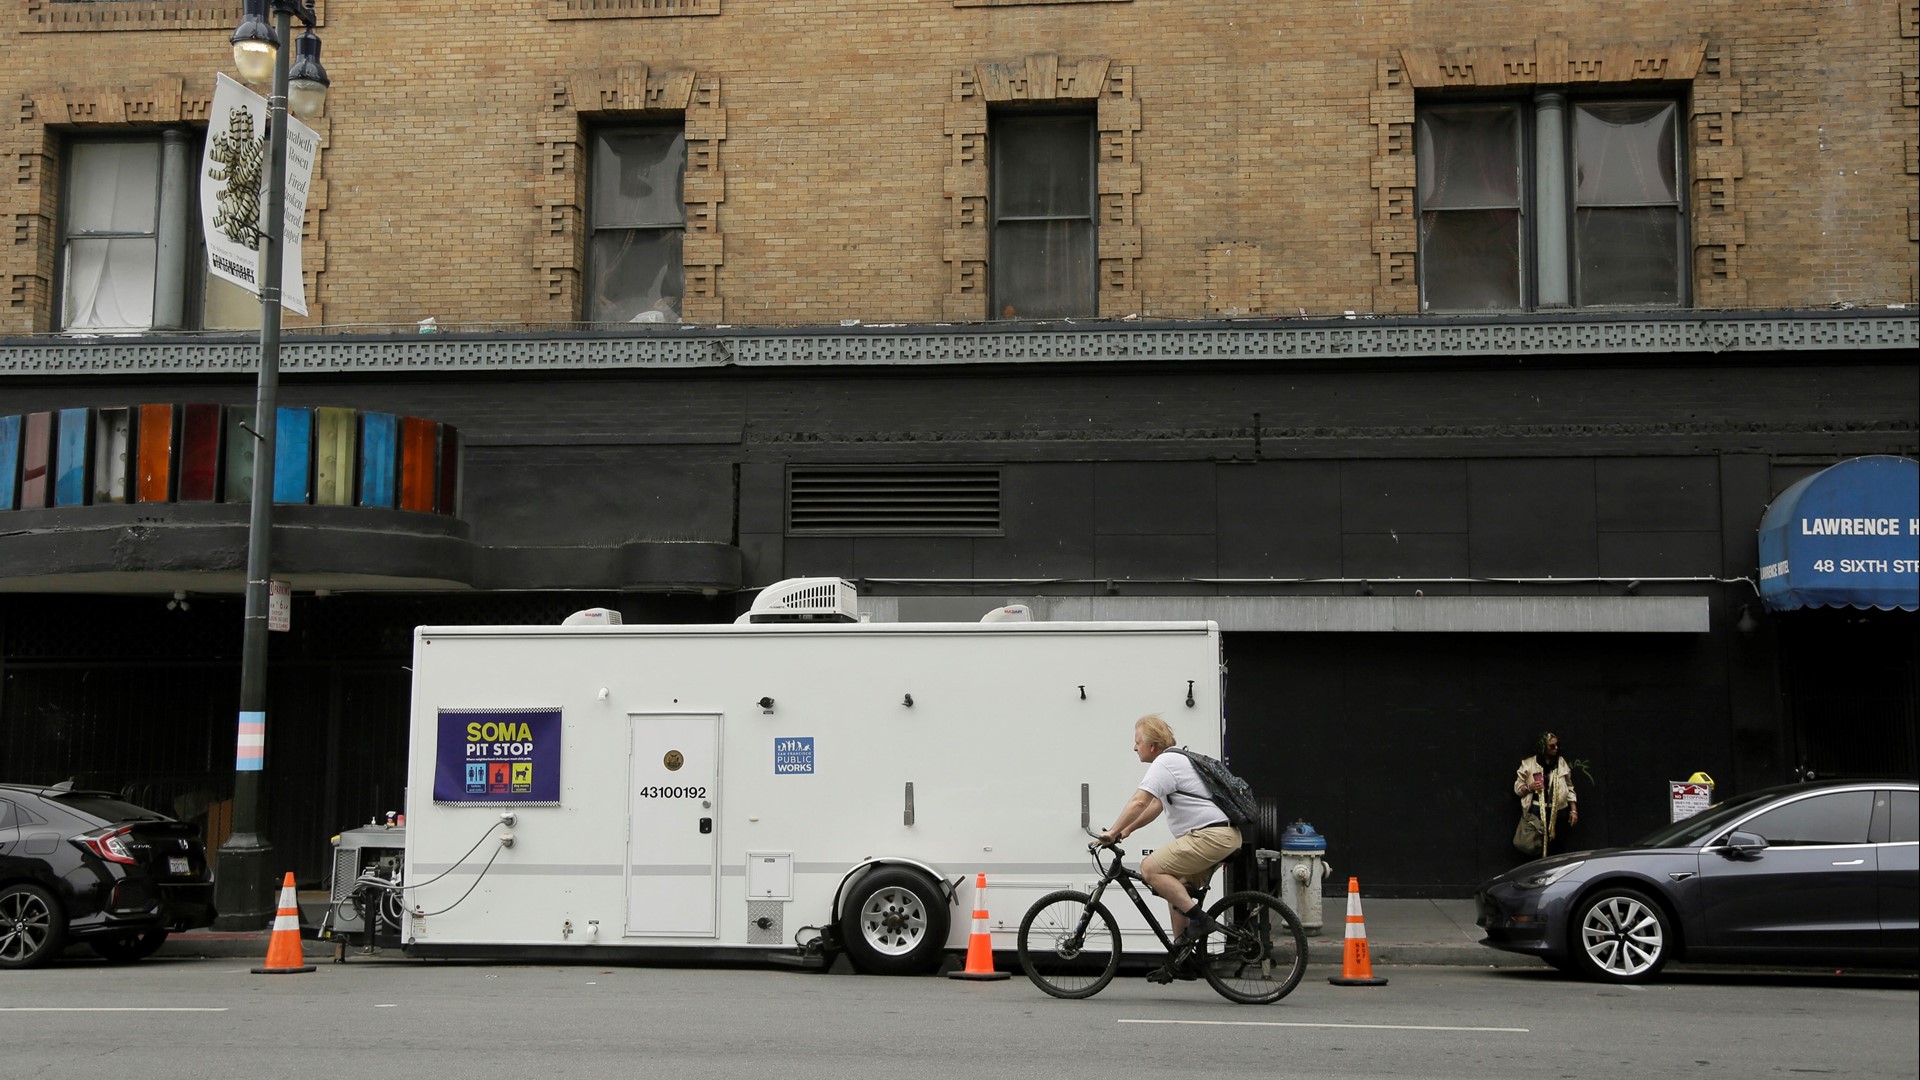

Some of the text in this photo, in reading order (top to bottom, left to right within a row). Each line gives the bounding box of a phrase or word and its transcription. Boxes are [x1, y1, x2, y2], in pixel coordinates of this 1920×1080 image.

[287, 129, 313, 154] nabeth
[288, 146, 309, 171] Rosen
[287, 172, 306, 195] Fired.
[1802, 518, 1900, 535] LAWRENCE
[1813, 559, 1835, 573] 48
[1840, 559, 1886, 573] SIXTH
[466, 722, 532, 741] SOMA
[466, 742, 534, 756] PIT STOP
[777, 755, 812, 764] PUBLIC
[777, 763, 812, 772] WORKS
[640, 786, 706, 799] 43100192
